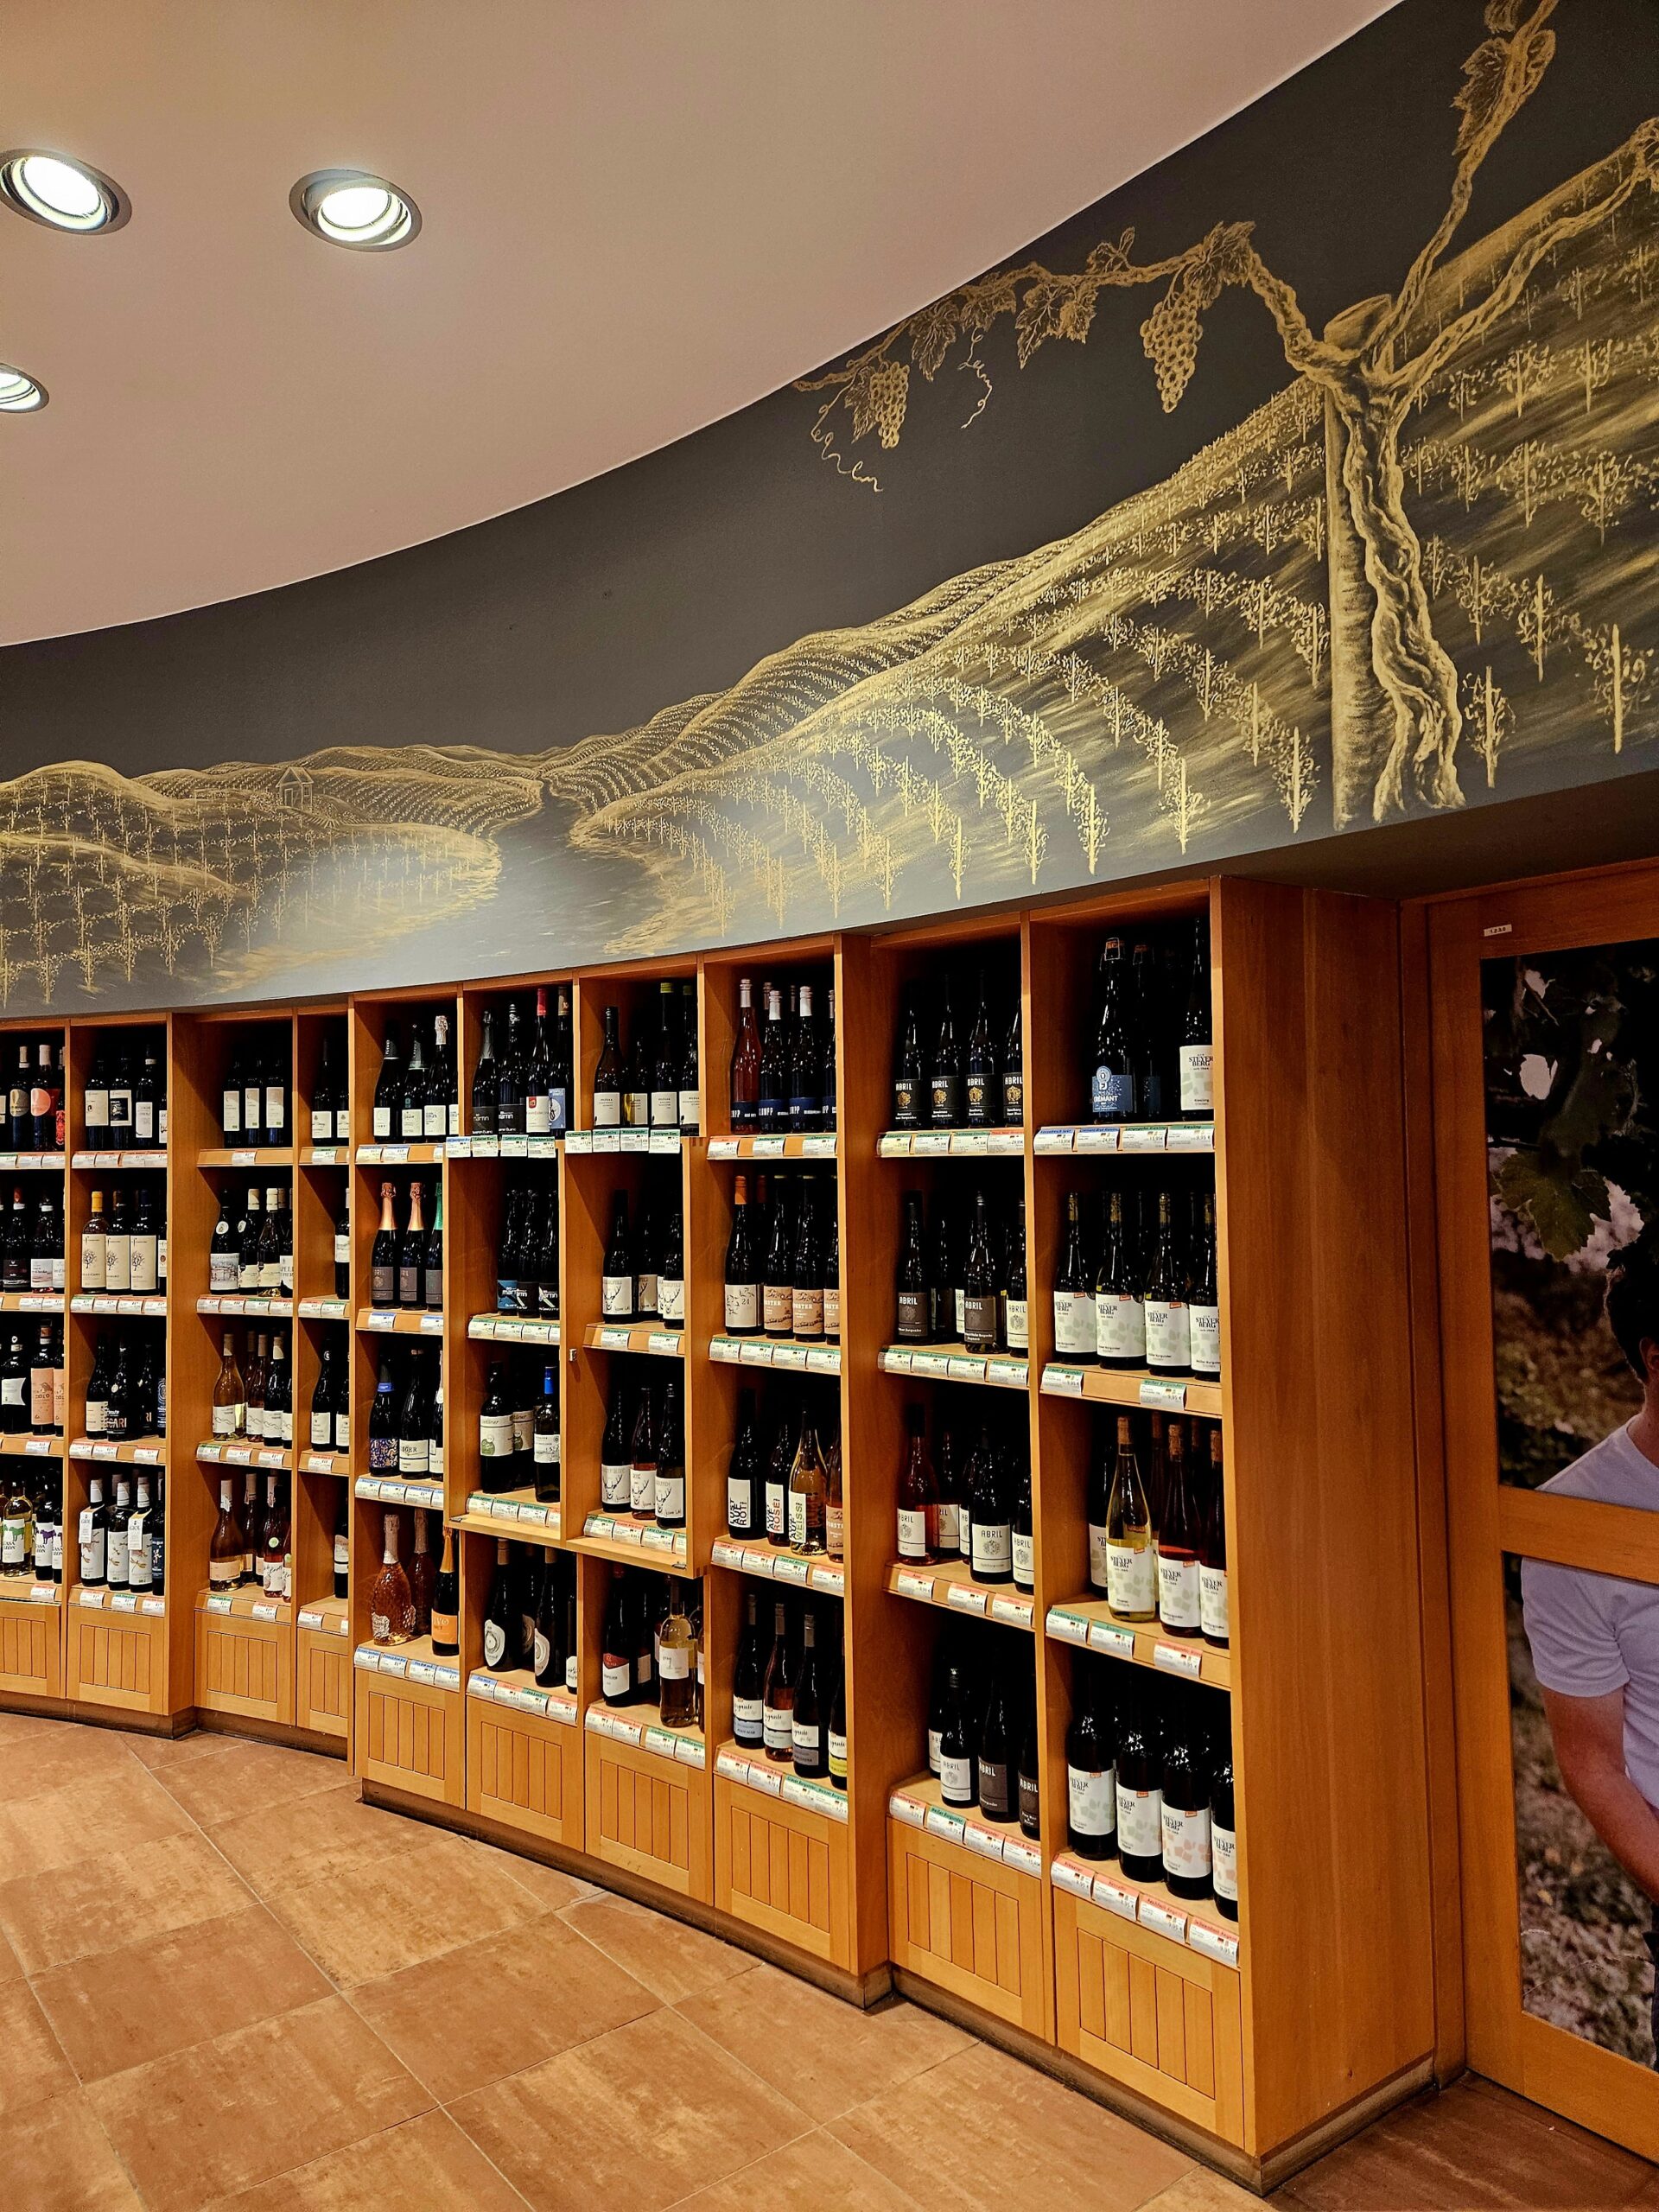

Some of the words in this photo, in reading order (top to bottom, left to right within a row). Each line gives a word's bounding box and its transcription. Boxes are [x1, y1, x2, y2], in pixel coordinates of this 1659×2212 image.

[931, 1080, 949, 1089] ABRIL
[967, 1077, 985, 1086] ABRIL
[1004, 1077, 1023, 1085] ABRIL
[899, 1296, 918, 1305] ABRIL
[965, 1300, 983, 1310] ABRIL
[898, 1513, 914, 1523] ABRIL
[1014, 1538, 1031, 1548] ABRIL
[943, 1760, 961, 1771] ABRIL
[978, 1762, 996, 1777] ABRIL
[1020, 1777, 1039, 1794] ABRIL
